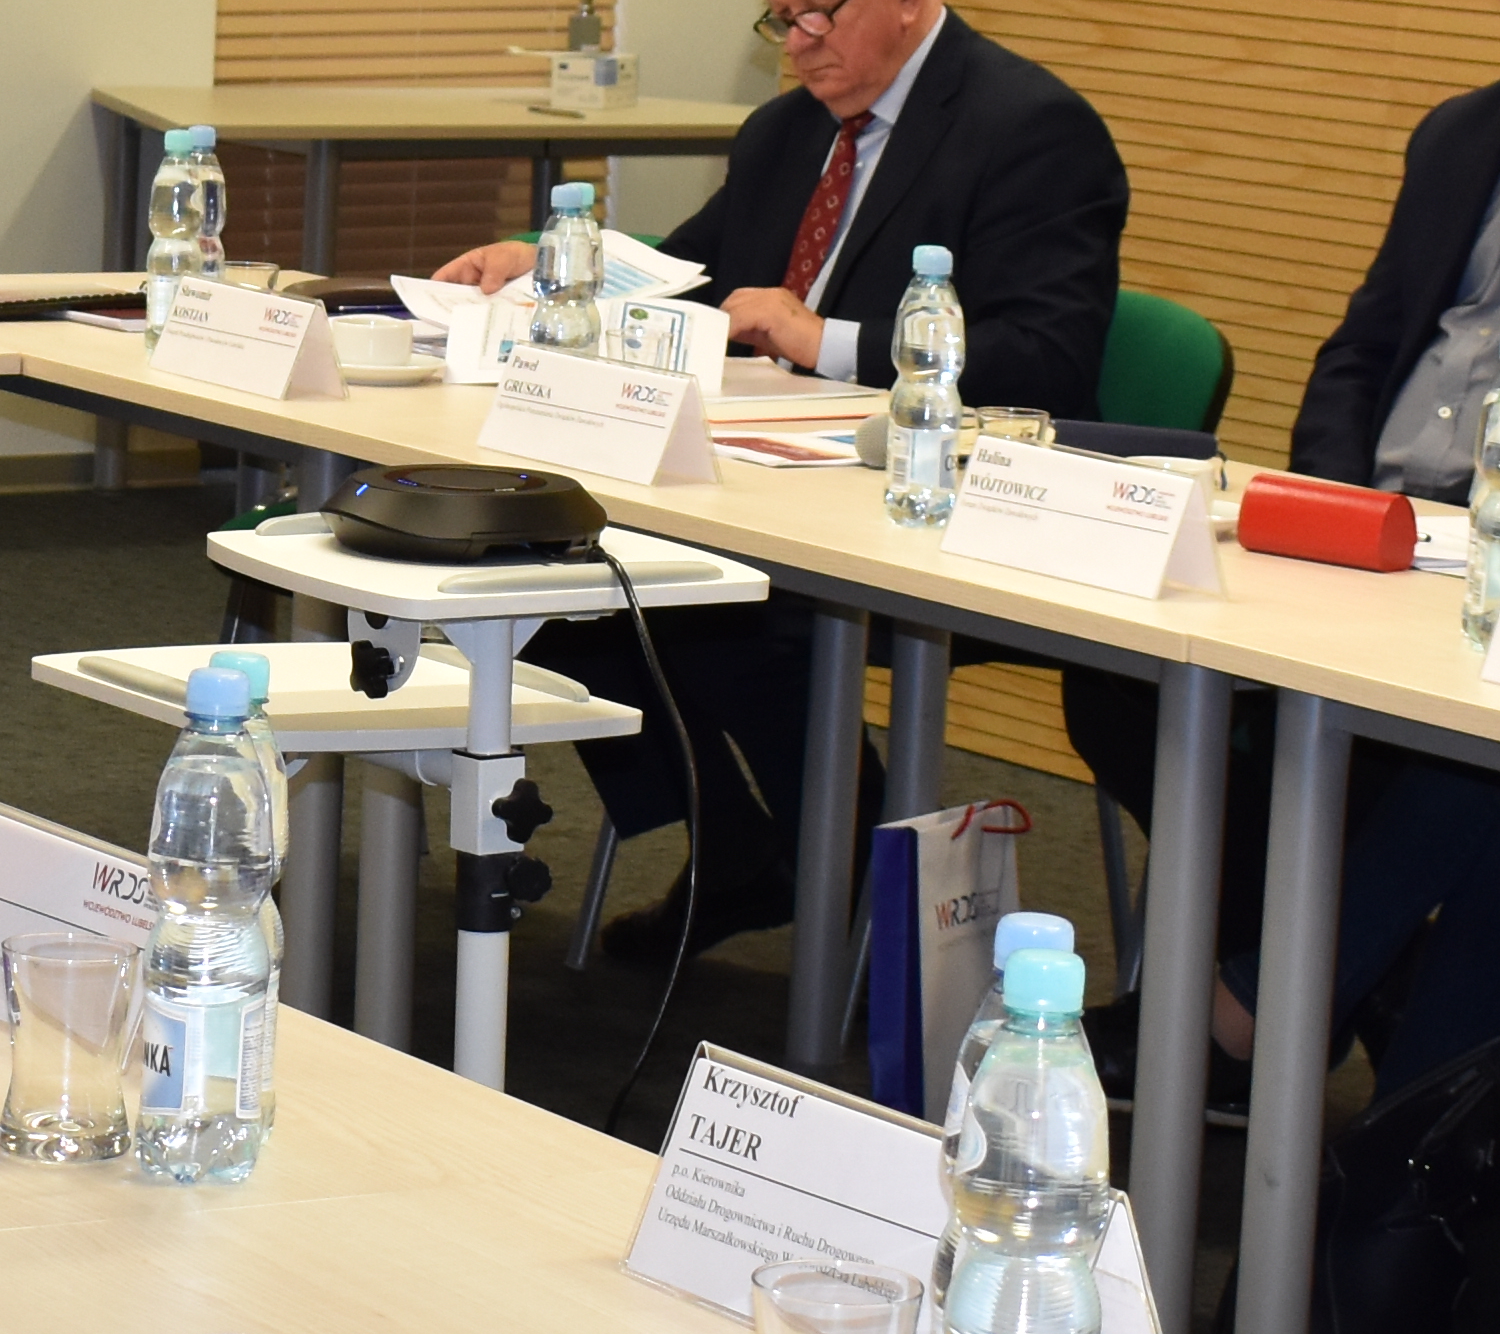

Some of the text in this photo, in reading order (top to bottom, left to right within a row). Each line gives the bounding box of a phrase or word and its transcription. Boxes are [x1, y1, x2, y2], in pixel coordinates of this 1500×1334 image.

[504, 378, 552, 399] GRUSZKA
[976, 448, 1012, 468] Halina
[969, 473, 1048, 502] WÓJTOWICZ
[1112, 481, 1157, 505] WRDS
[92, 861, 149, 904] WRDS
[702, 1065, 805, 1119] Krzysztof
[688, 1112, 763, 1163] TAJER
[671, 1163, 746, 1198] p.o. Kierownika
[658, 1207, 691, 1231] Urzędu
[691, 1218, 779, 1264] Marszałkowskiego
[665, 1184, 706, 1210] Oddziału
[707, 1197, 776, 1235] Drogownictwa
[784, 1225, 815, 1249] Ruchu
